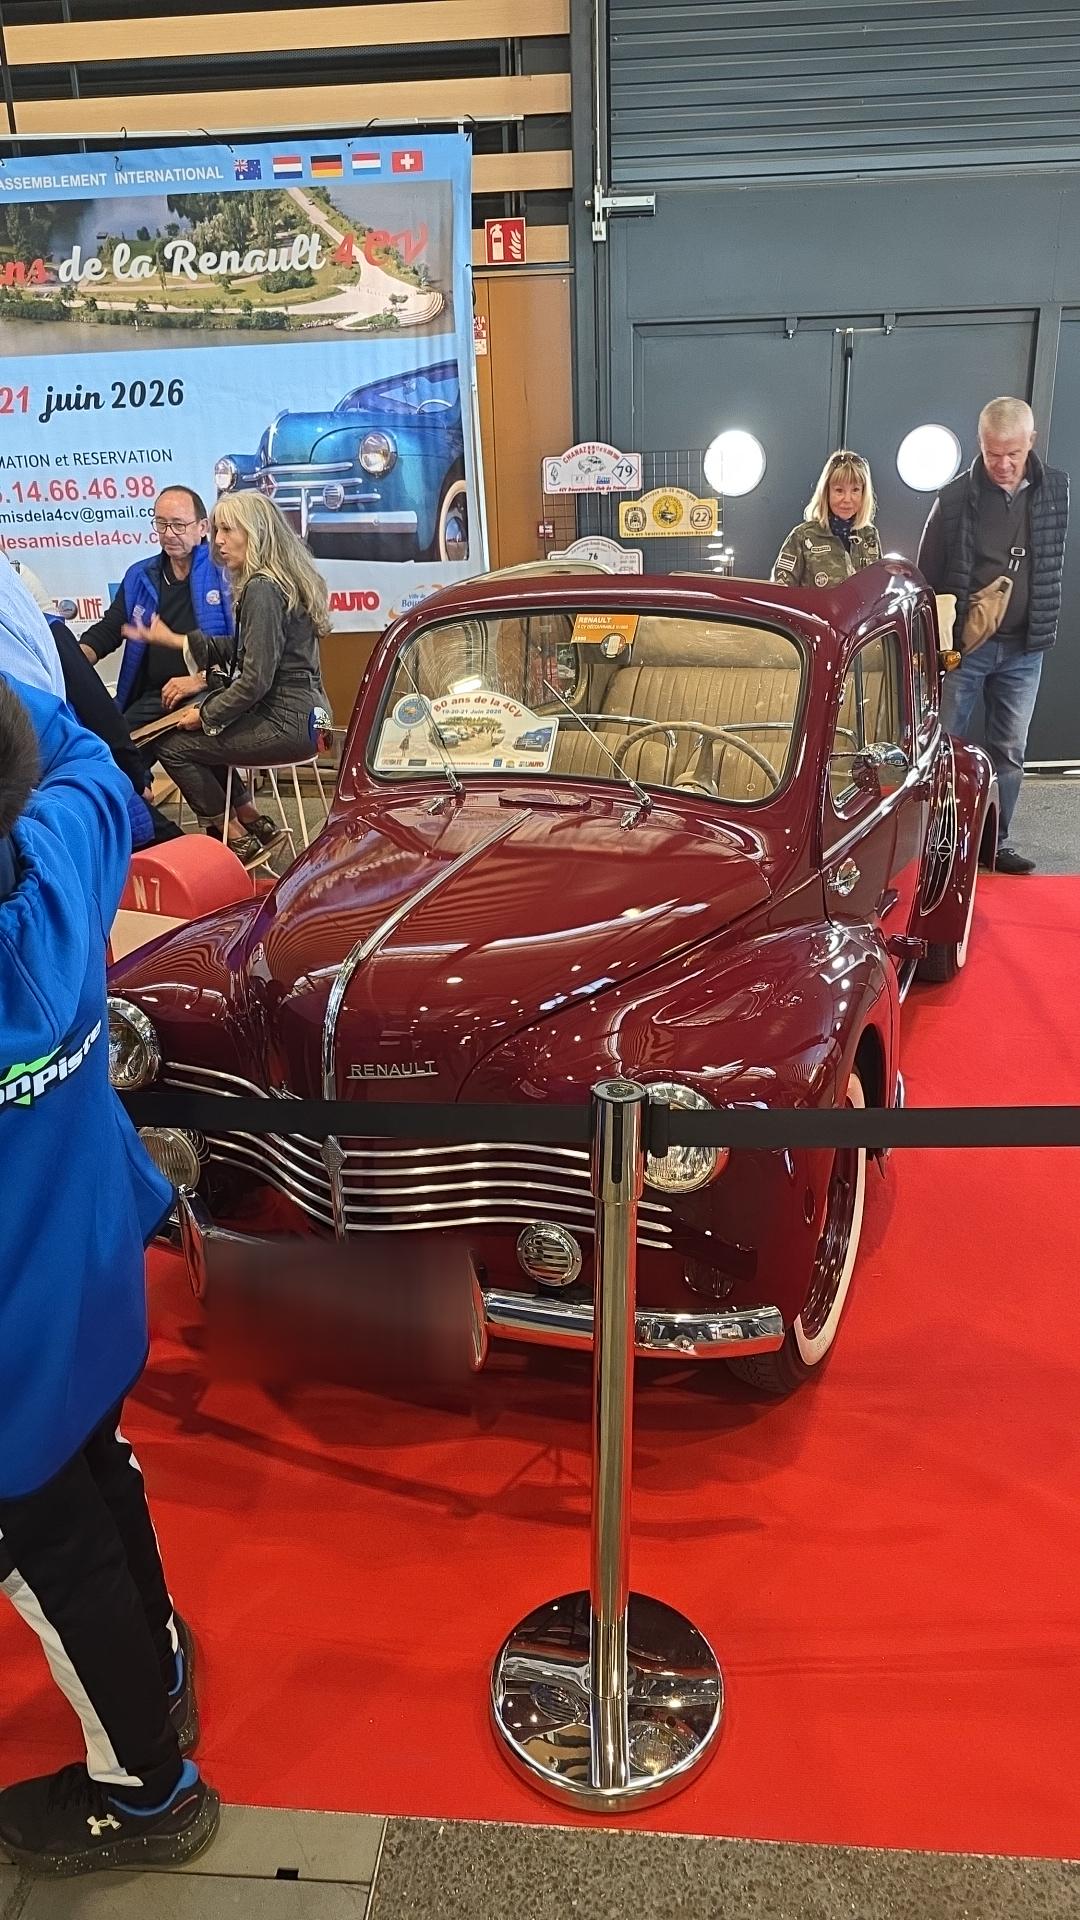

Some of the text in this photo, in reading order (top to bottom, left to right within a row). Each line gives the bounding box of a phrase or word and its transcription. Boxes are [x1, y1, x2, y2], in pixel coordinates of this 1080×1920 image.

[114, 166, 225, 186] INTERNATIONAL
[0, 258, 52, 287] ns
[59, 246, 108, 283] de
[113, 243, 157, 280] la
[164, 233, 327, 282] Renault
[38, 384, 105, 423] juin
[111, 379, 184, 409] 2026
[55, 456, 70, 467] et
[73, 449, 173, 467] RESERVATION
[617, 465, 633, 478] 79
[0, 476, 156, 503] .14.66.46.98
[694, 512, 708, 523] 22
[588, 553, 598, 561] 76
[328, 591, 380, 612] AUTO
[578, 616, 612, 624] RENAULT
[451, 697, 471, 705] ans
[474, 696, 488, 704] de
[490, 697, 501, 706] la
[502, 701, 523, 718] 4CV
[350, 1060, 436, 1077] RENAULT
